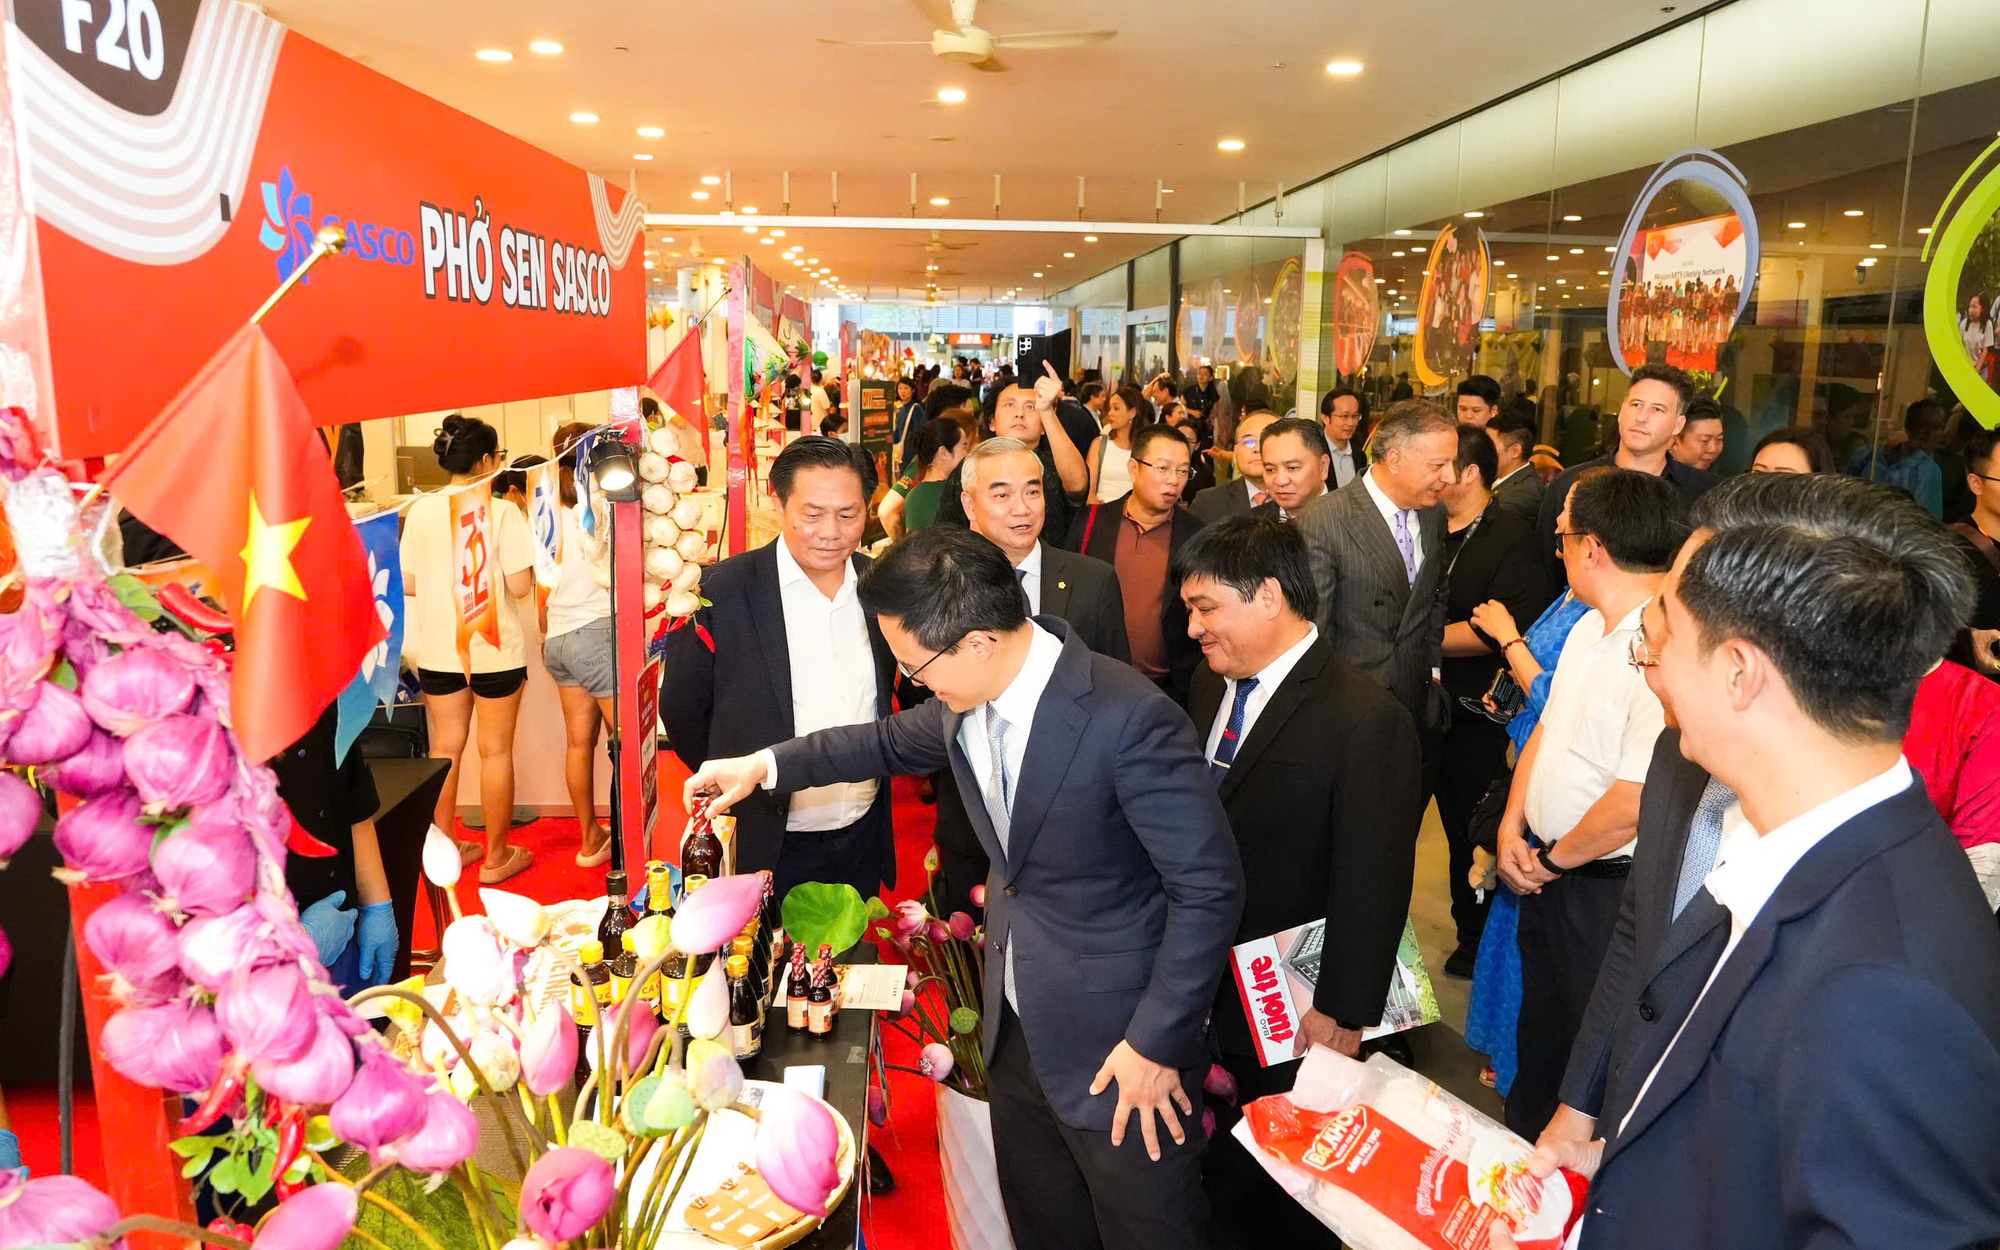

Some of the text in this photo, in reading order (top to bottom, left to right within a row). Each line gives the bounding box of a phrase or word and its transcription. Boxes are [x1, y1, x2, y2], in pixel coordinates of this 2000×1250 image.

[61, 0, 165, 81] F20
[419, 195, 611, 317] PHỞ SEN SASCO
